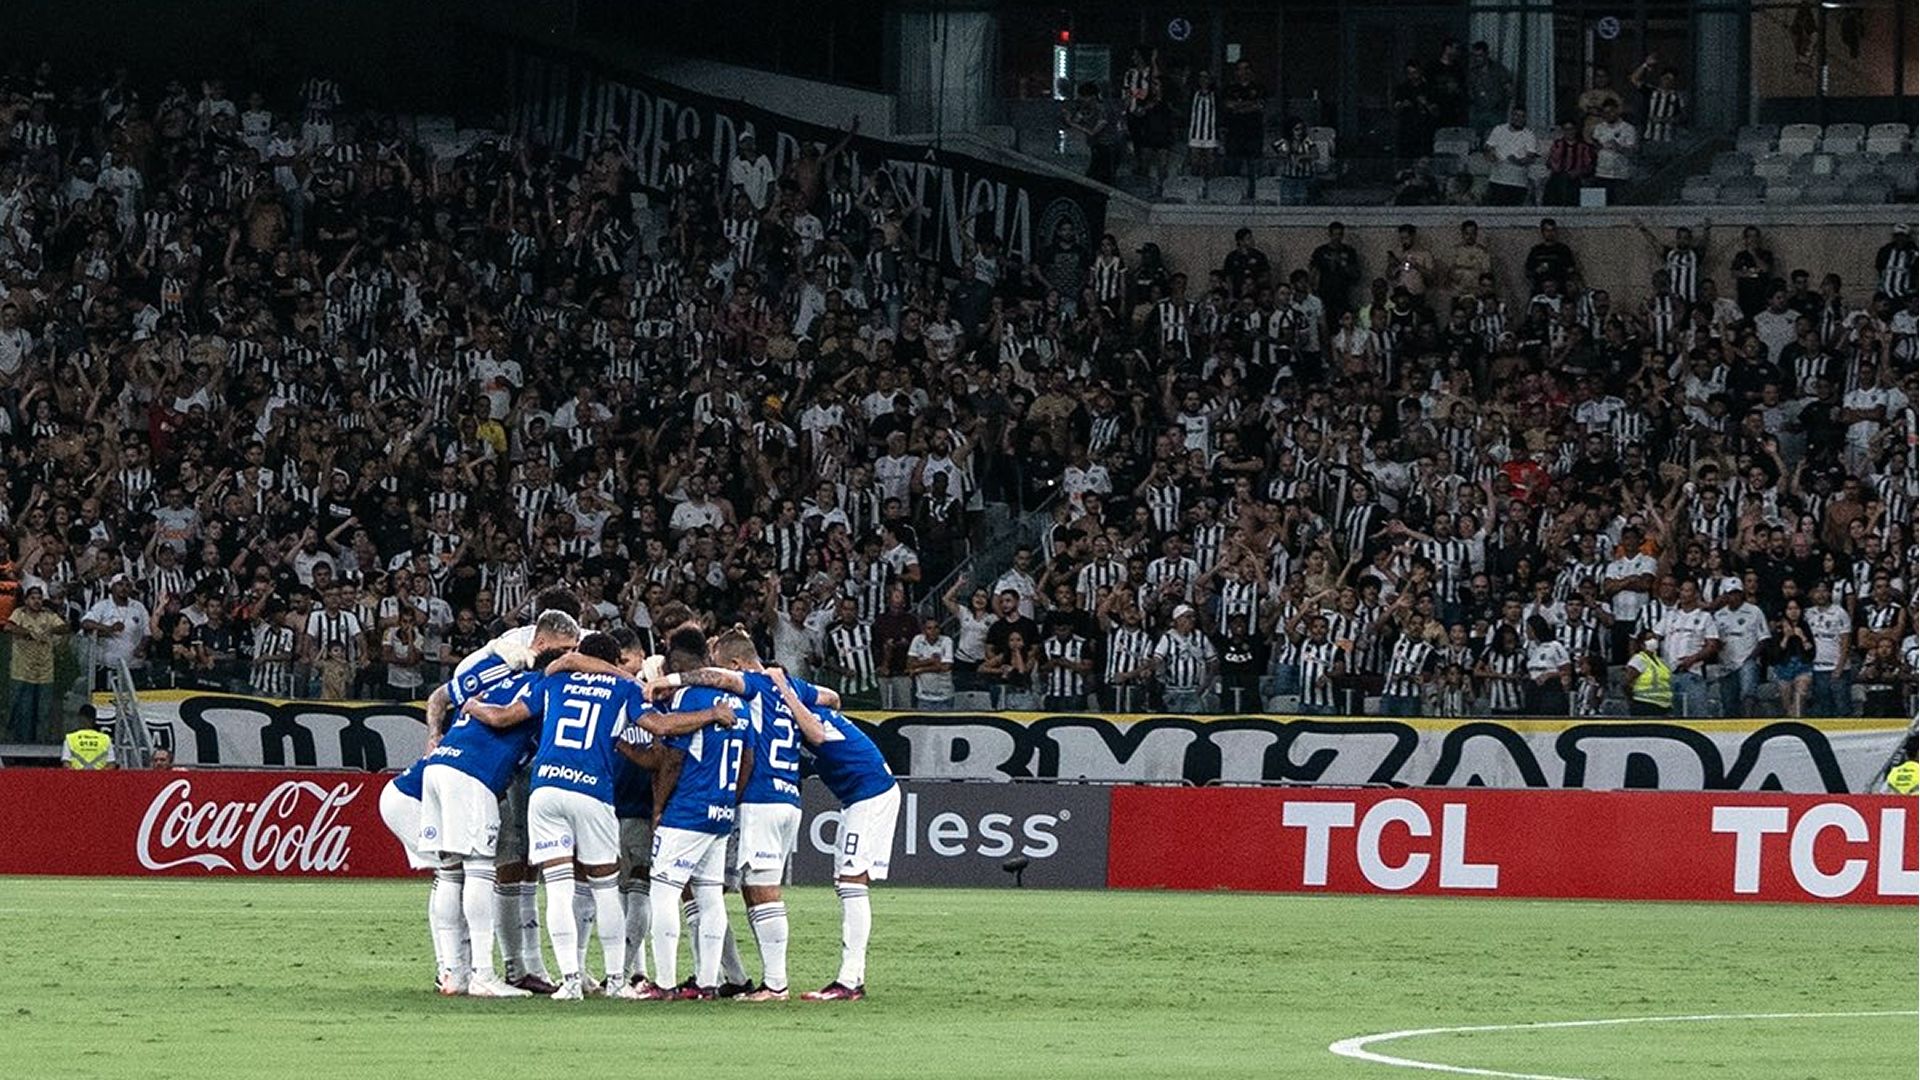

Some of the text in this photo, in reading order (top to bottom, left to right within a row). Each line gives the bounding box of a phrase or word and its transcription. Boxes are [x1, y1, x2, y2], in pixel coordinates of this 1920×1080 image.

[554, 699, 602, 750] 21
[563, 683, 612, 700] PEREIRA
[137, 779, 364, 873] Coca-Cola
[845, 833, 858, 855] 8
[1282, 798, 1499, 891] TCL
[1712, 803, 1919, 897] TCL
